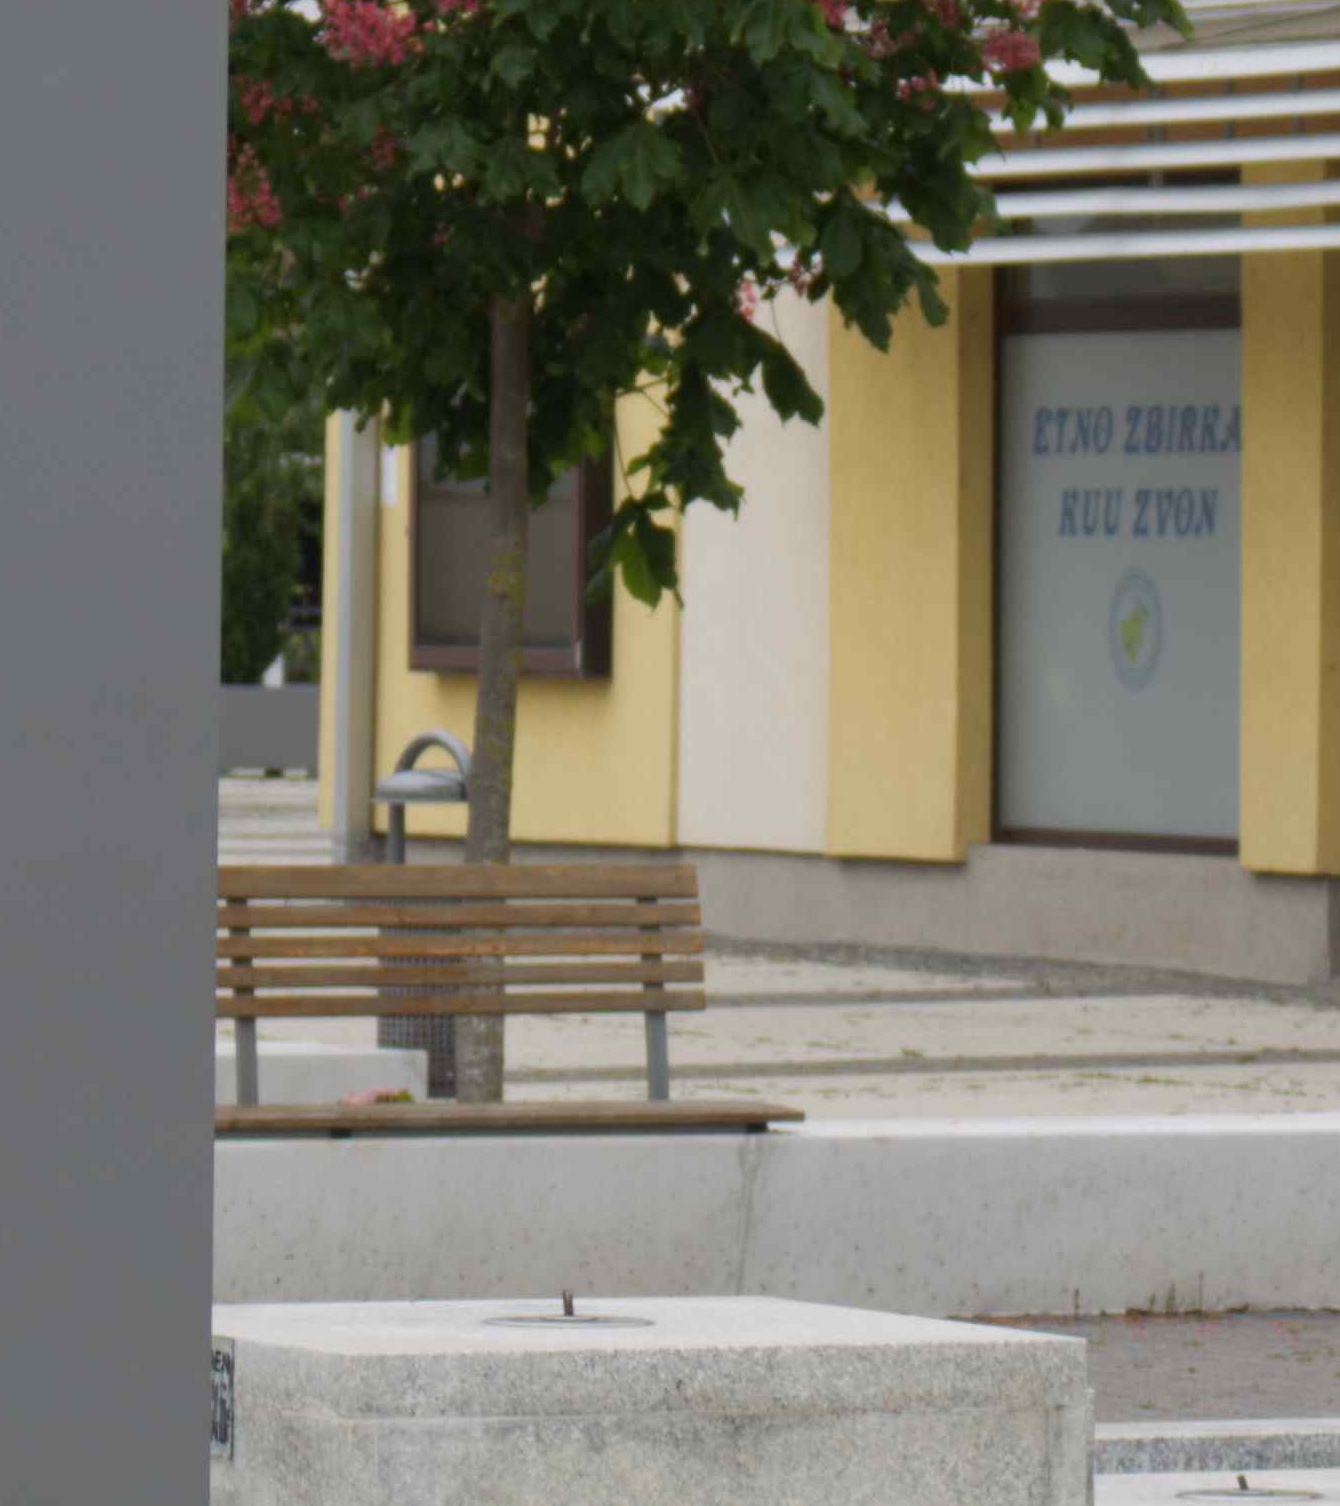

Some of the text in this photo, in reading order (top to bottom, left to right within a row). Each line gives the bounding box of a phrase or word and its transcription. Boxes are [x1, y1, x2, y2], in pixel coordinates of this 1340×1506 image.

[1033, 403, 1242, 455] ETNO ZBIRKA
[1132, 486, 1219, 537] ZVON
